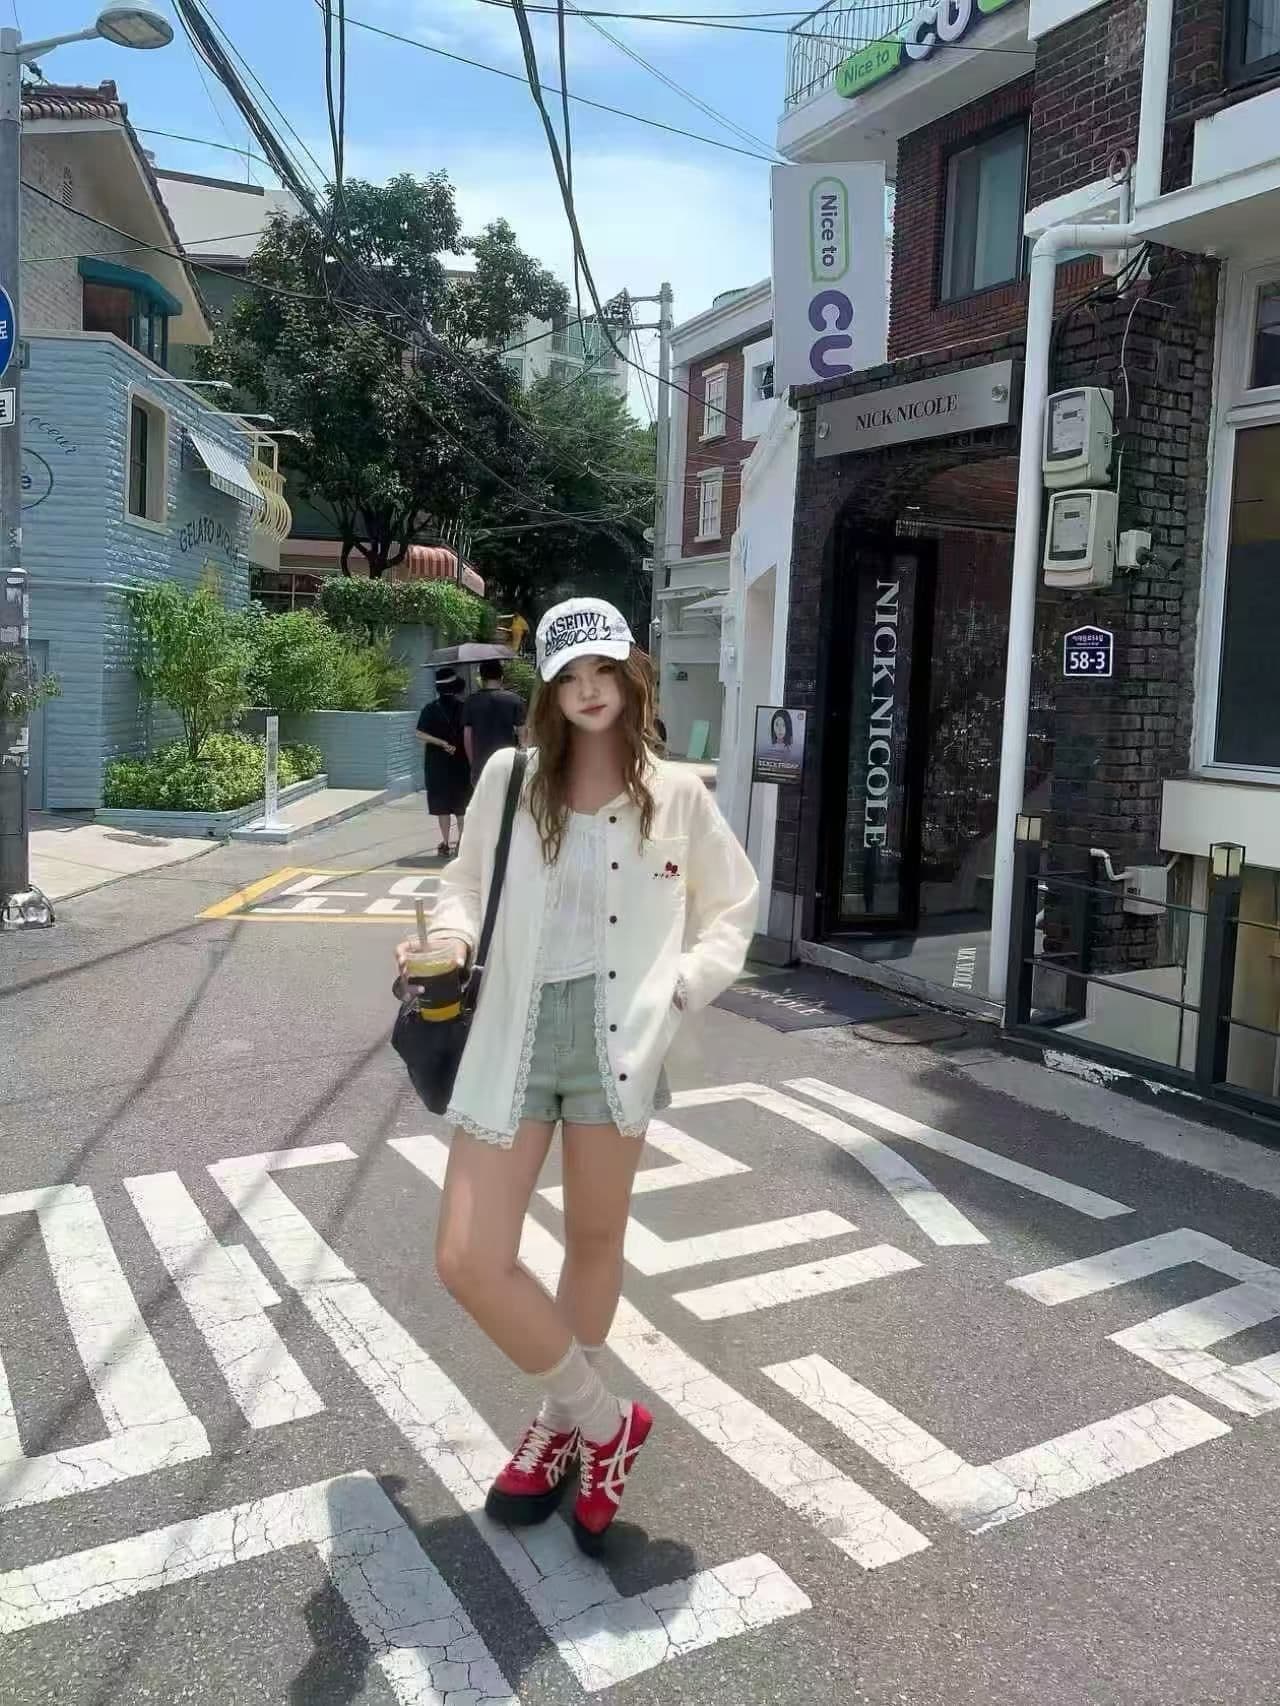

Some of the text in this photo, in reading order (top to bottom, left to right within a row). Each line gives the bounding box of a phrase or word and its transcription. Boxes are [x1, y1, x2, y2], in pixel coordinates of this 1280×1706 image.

[905, 0, 972, 60] CU
[844, 50, 889, 86] Nice to
[821, 194, 837, 267] Nice to
[808, 290, 853, 378] CU
[856, 393, 960, 430] NICK NICOLE
[180, 516, 215, 552] GELATO
[1070, 651, 1105, 670] 58-3
[863, 579, 900, 848] NICK NICOLE
